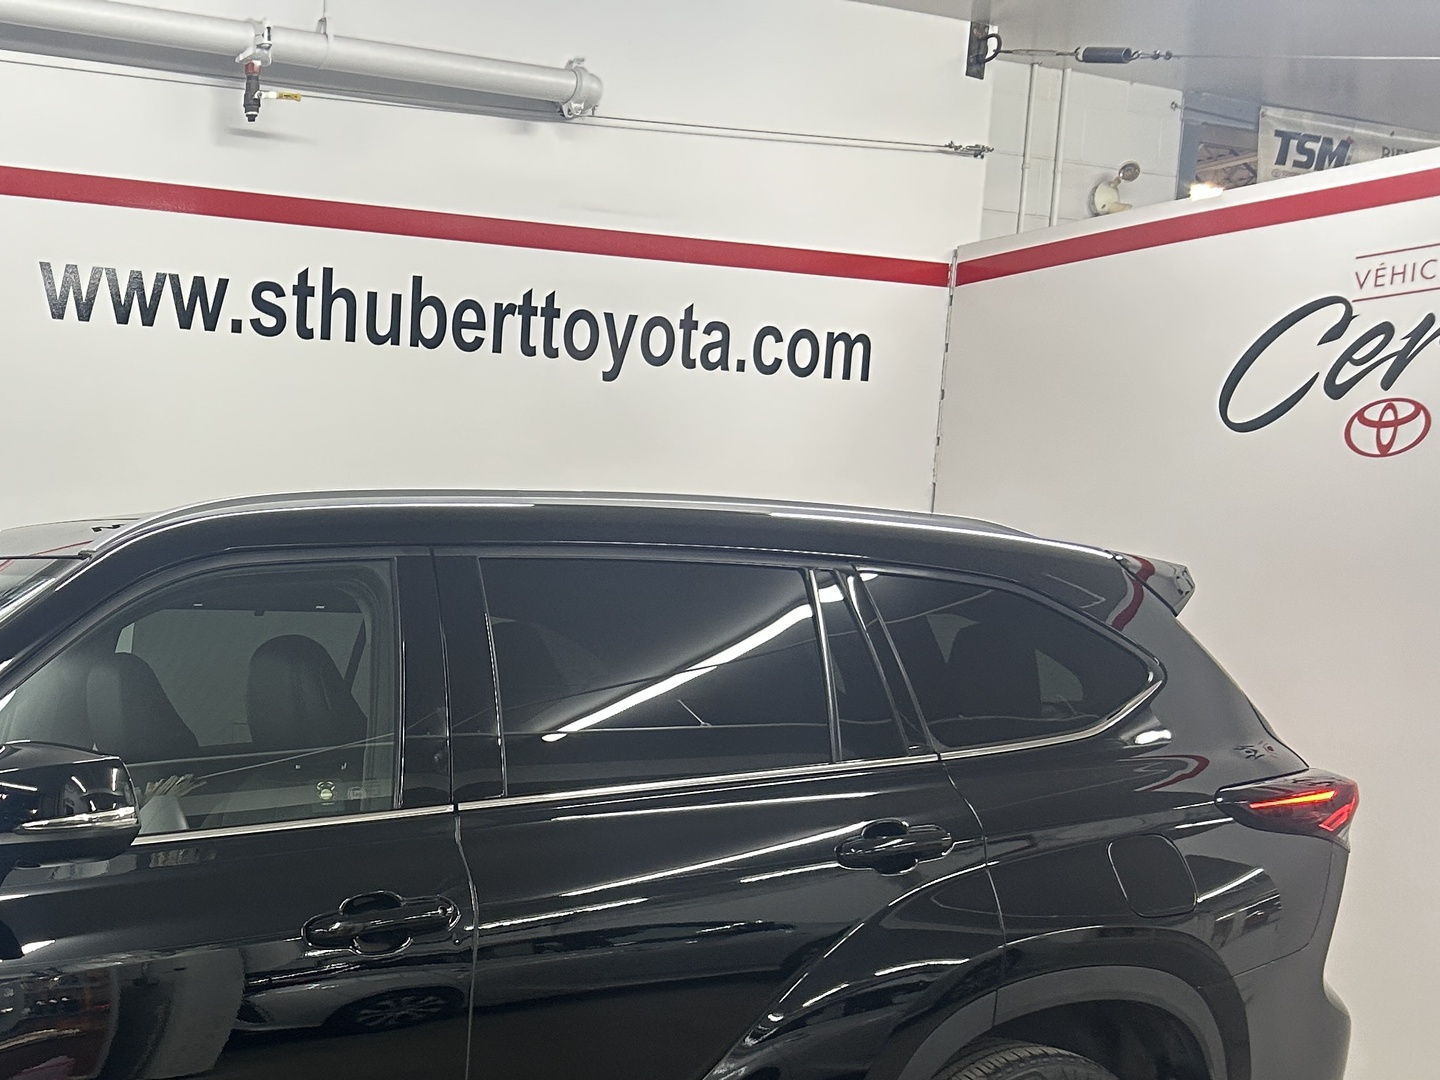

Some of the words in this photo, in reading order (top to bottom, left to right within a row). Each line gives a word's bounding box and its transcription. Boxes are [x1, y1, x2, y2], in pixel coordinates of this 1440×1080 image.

[1274, 129, 1353, 171] TSM
[1355, 261, 1438, 290] VÉHIC
[38, 261, 872, 383] www.sthuberttoyota.com
